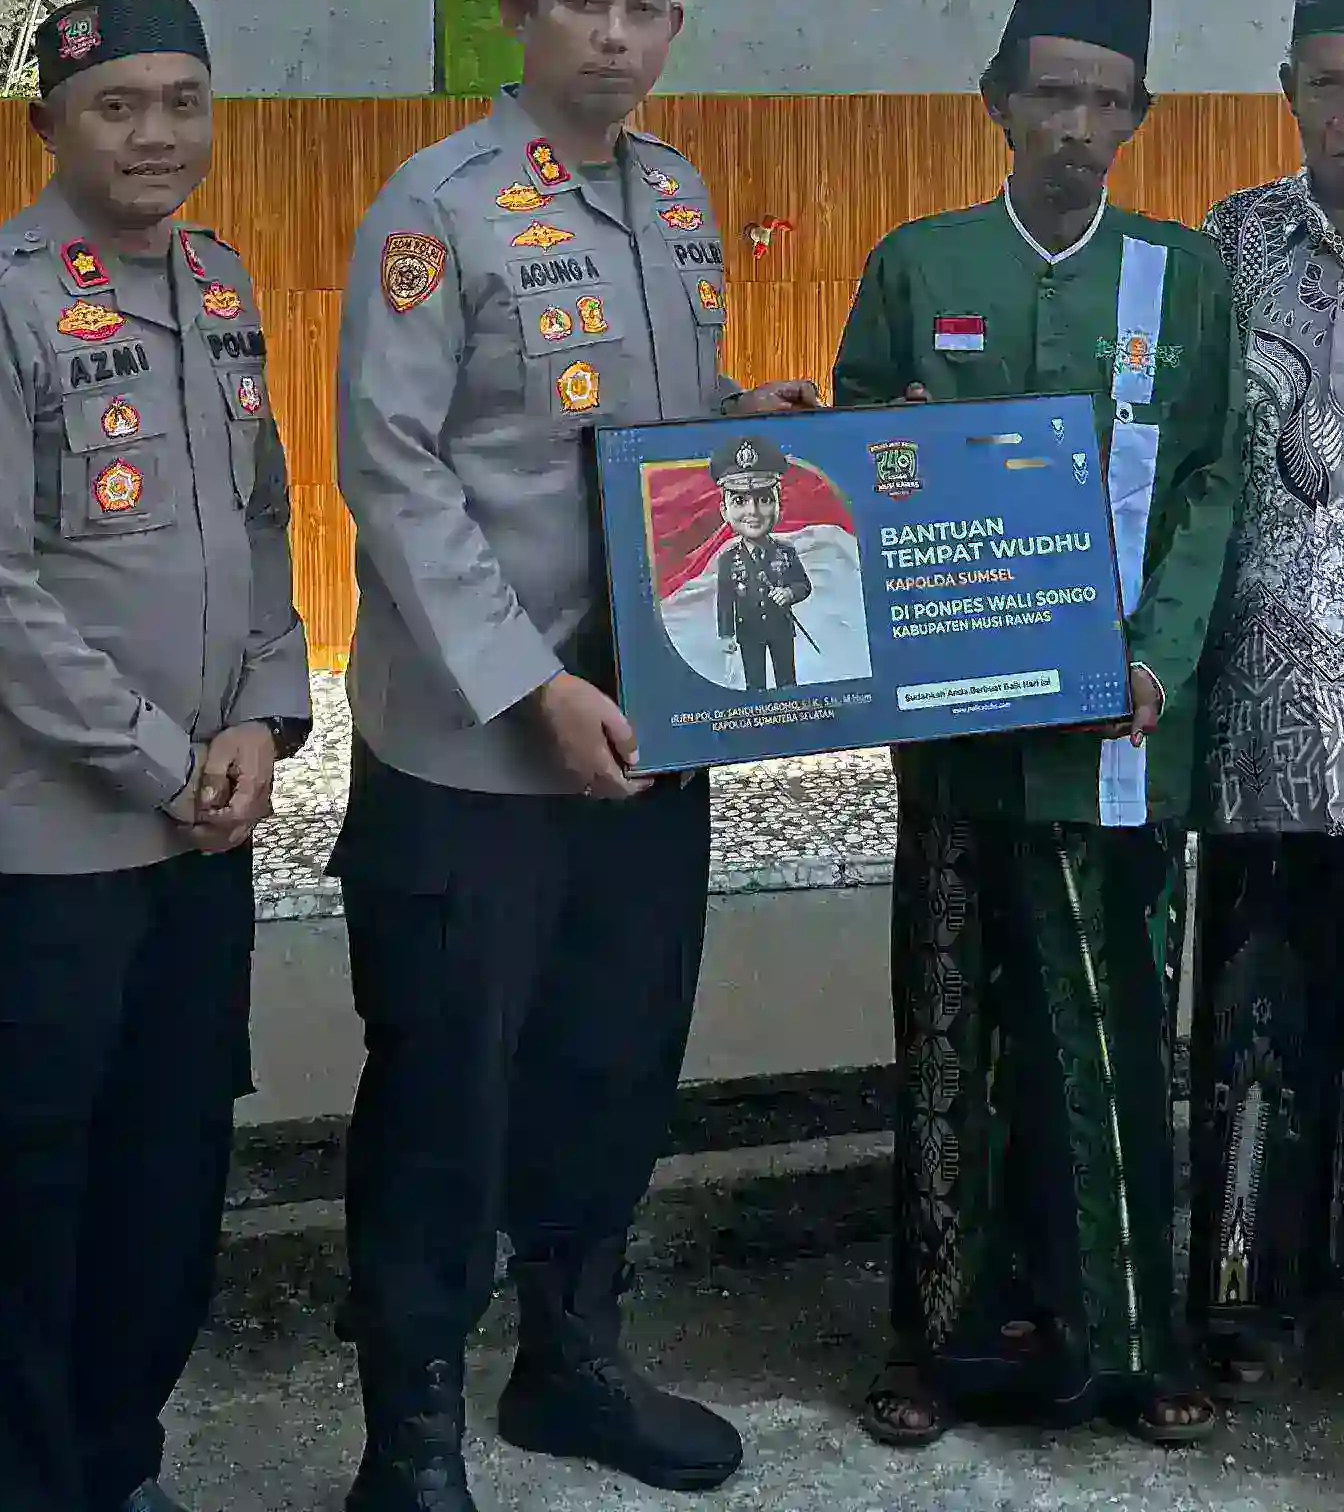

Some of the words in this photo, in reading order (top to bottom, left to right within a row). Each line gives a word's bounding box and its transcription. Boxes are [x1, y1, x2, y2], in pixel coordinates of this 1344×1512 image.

[520, 258, 583, 289] AGUNG
[71, 344, 150, 388] AZMI
[880, 517, 1004, 547] BANTUAN
[881, 541, 984, 569] TEMPAT
[990, 532, 1092, 560] WUDHU
[885, 573, 956, 592] KAPOLDA
[957, 568, 1015, 586] SUMSEL
[890, 604, 910, 622] DI
[913, 597, 985, 620] PONPES
[987, 592, 1032, 612] WALI
[1036, 586, 1097, 607] SONGO
[892, 618, 969, 639] KABUPATEN
[971, 615, 1003, 630] MUSI
[1005, 610, 1052, 627] RAWAS
